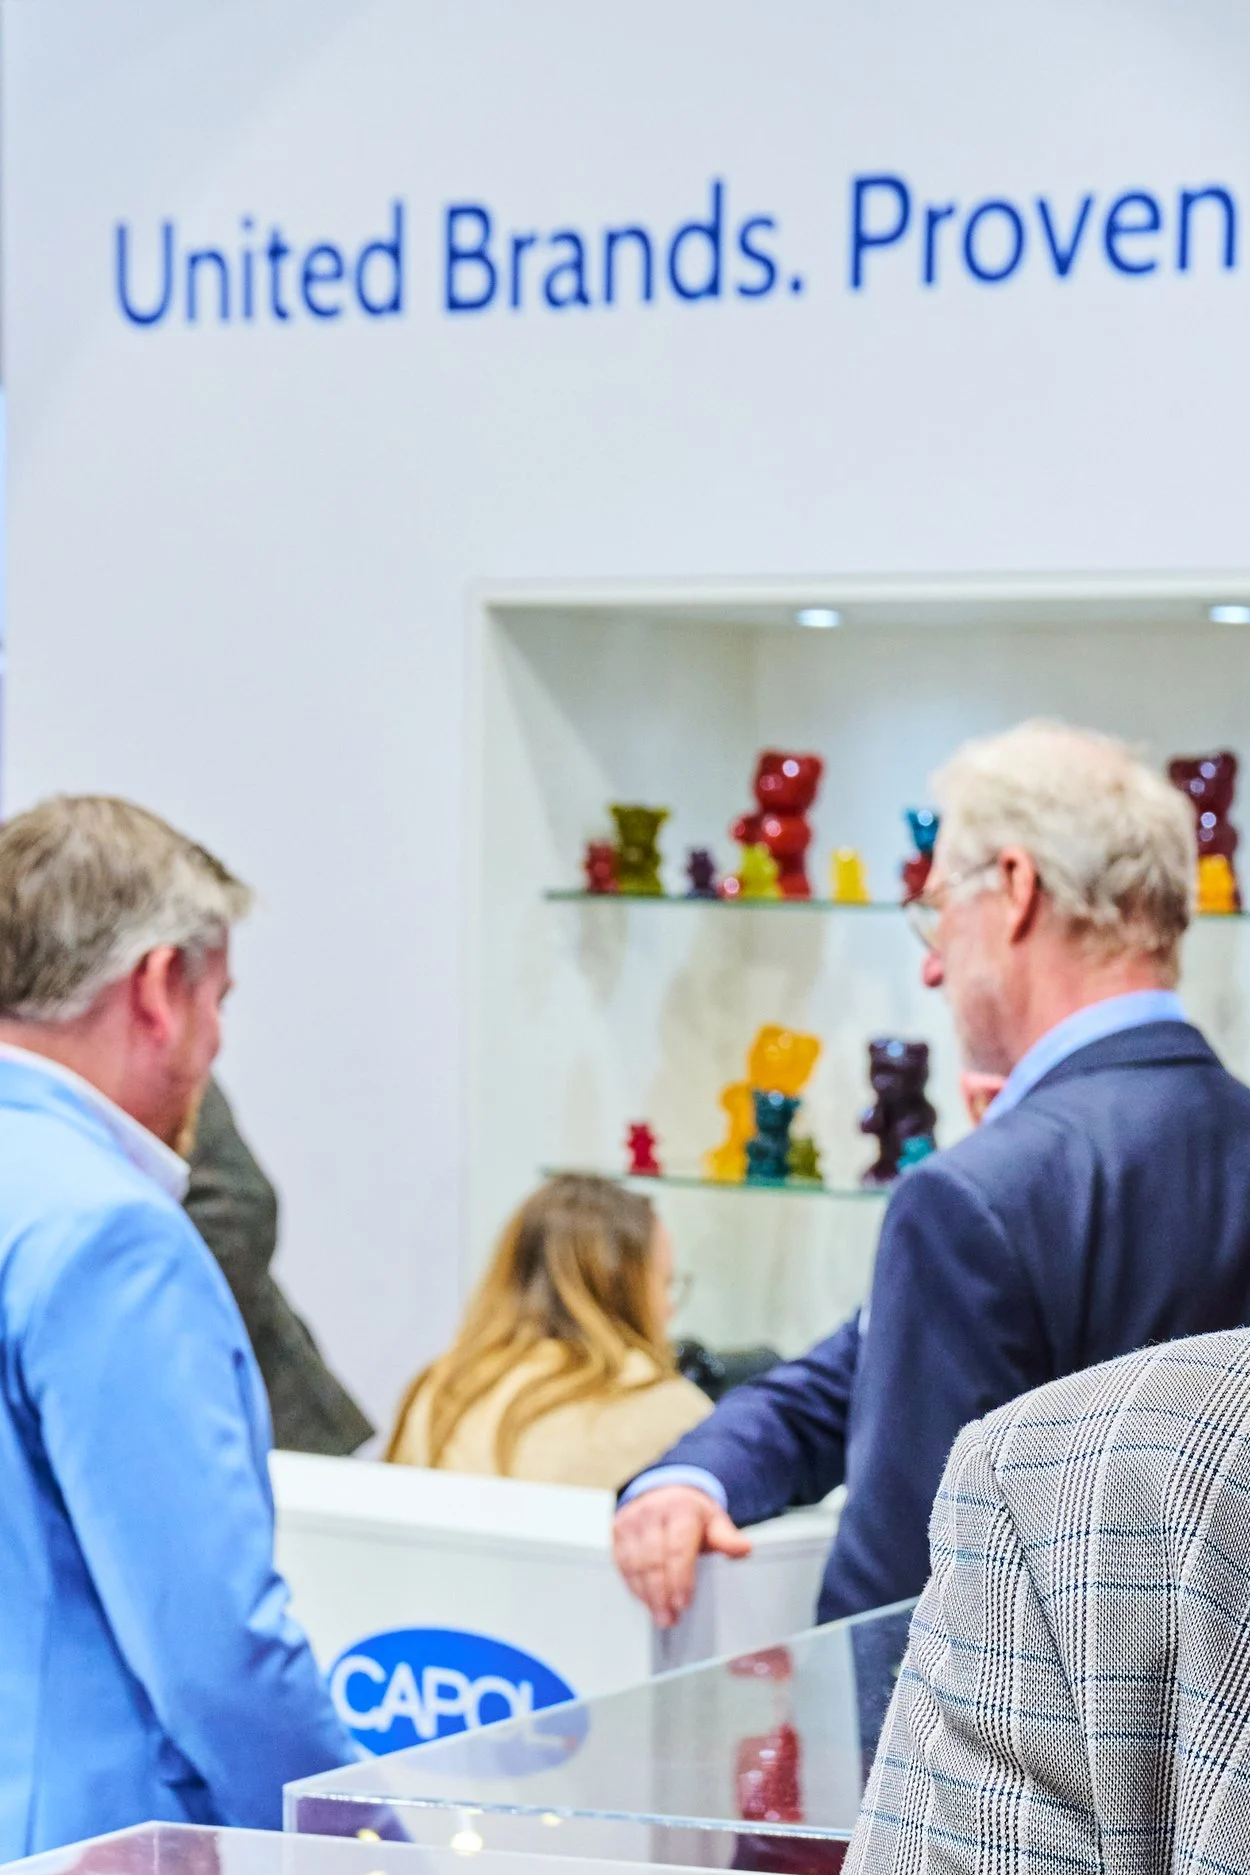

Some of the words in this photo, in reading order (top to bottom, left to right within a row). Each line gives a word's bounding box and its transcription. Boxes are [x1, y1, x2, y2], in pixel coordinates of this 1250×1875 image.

[115, 200, 404, 329] United
[443, 178, 805, 315] Brands.
[848, 172, 1239, 293] Proven
